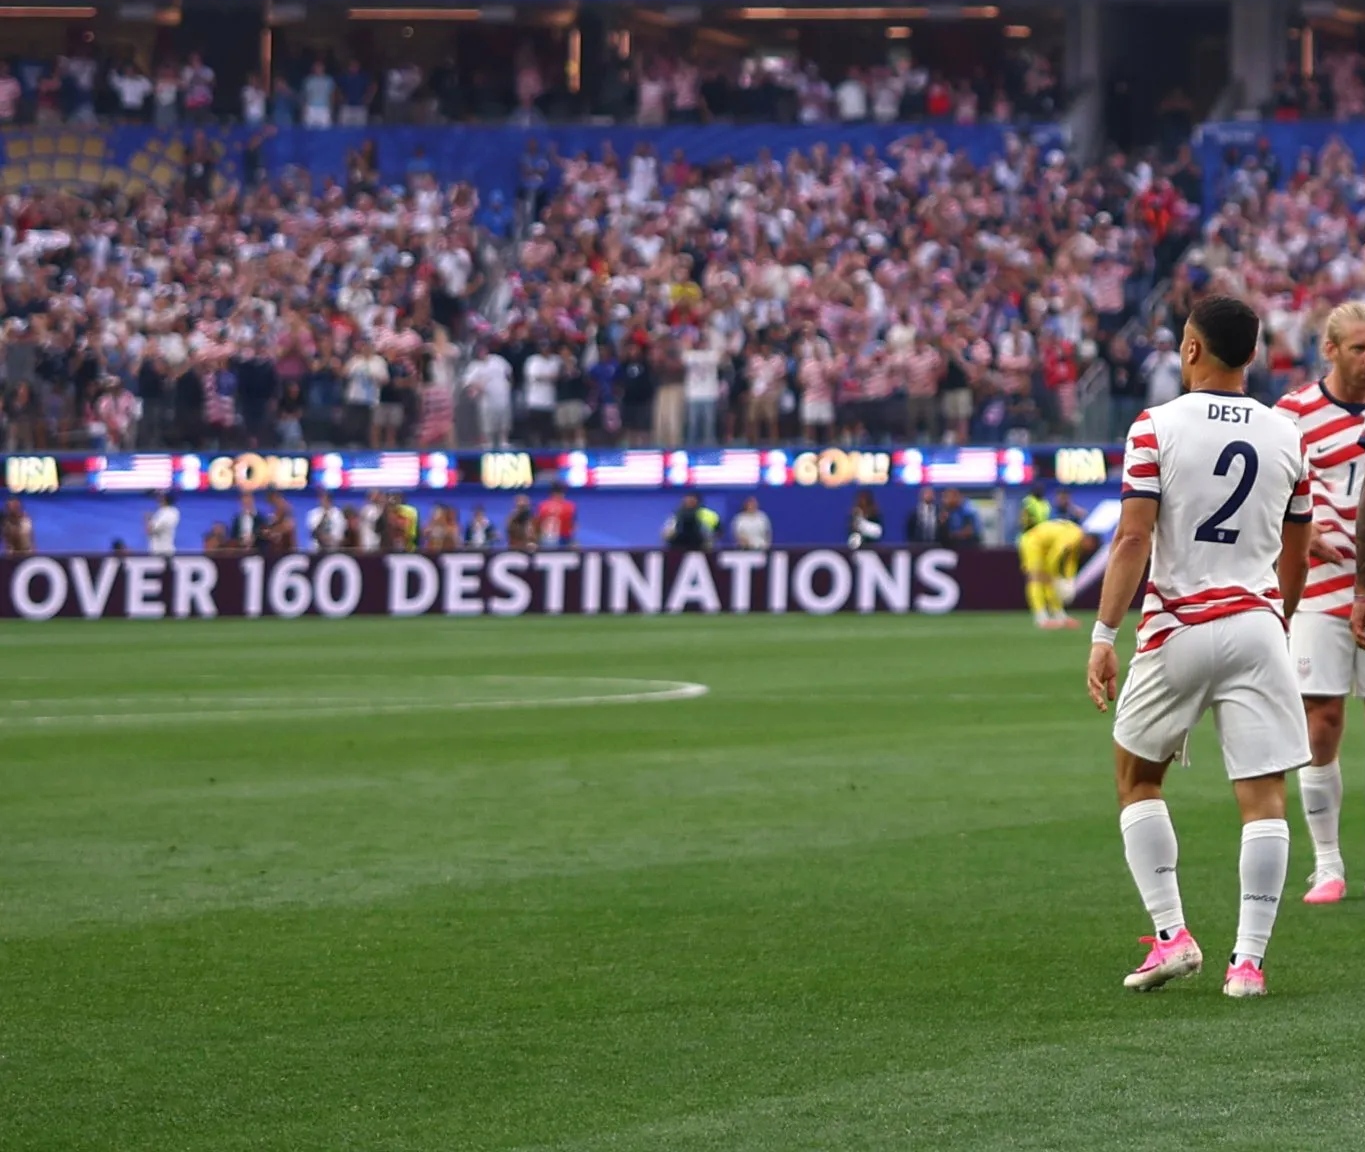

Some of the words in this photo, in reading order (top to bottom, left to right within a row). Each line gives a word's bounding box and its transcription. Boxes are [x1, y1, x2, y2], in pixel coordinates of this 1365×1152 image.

[1207, 403, 1253, 424] DEST
[6, 453, 59, 493] USA
[208, 452, 308, 491] GOAL!
[481, 452, 534, 489] USA
[793, 448, 890, 488] GOAL!
[1346, 461, 1357, 496] 1
[1194, 440, 1259, 544] 2
[11, 556, 219, 619] OVER
[242, 554, 362, 617] 160
[387, 551, 961, 616] DESTINATIONS
